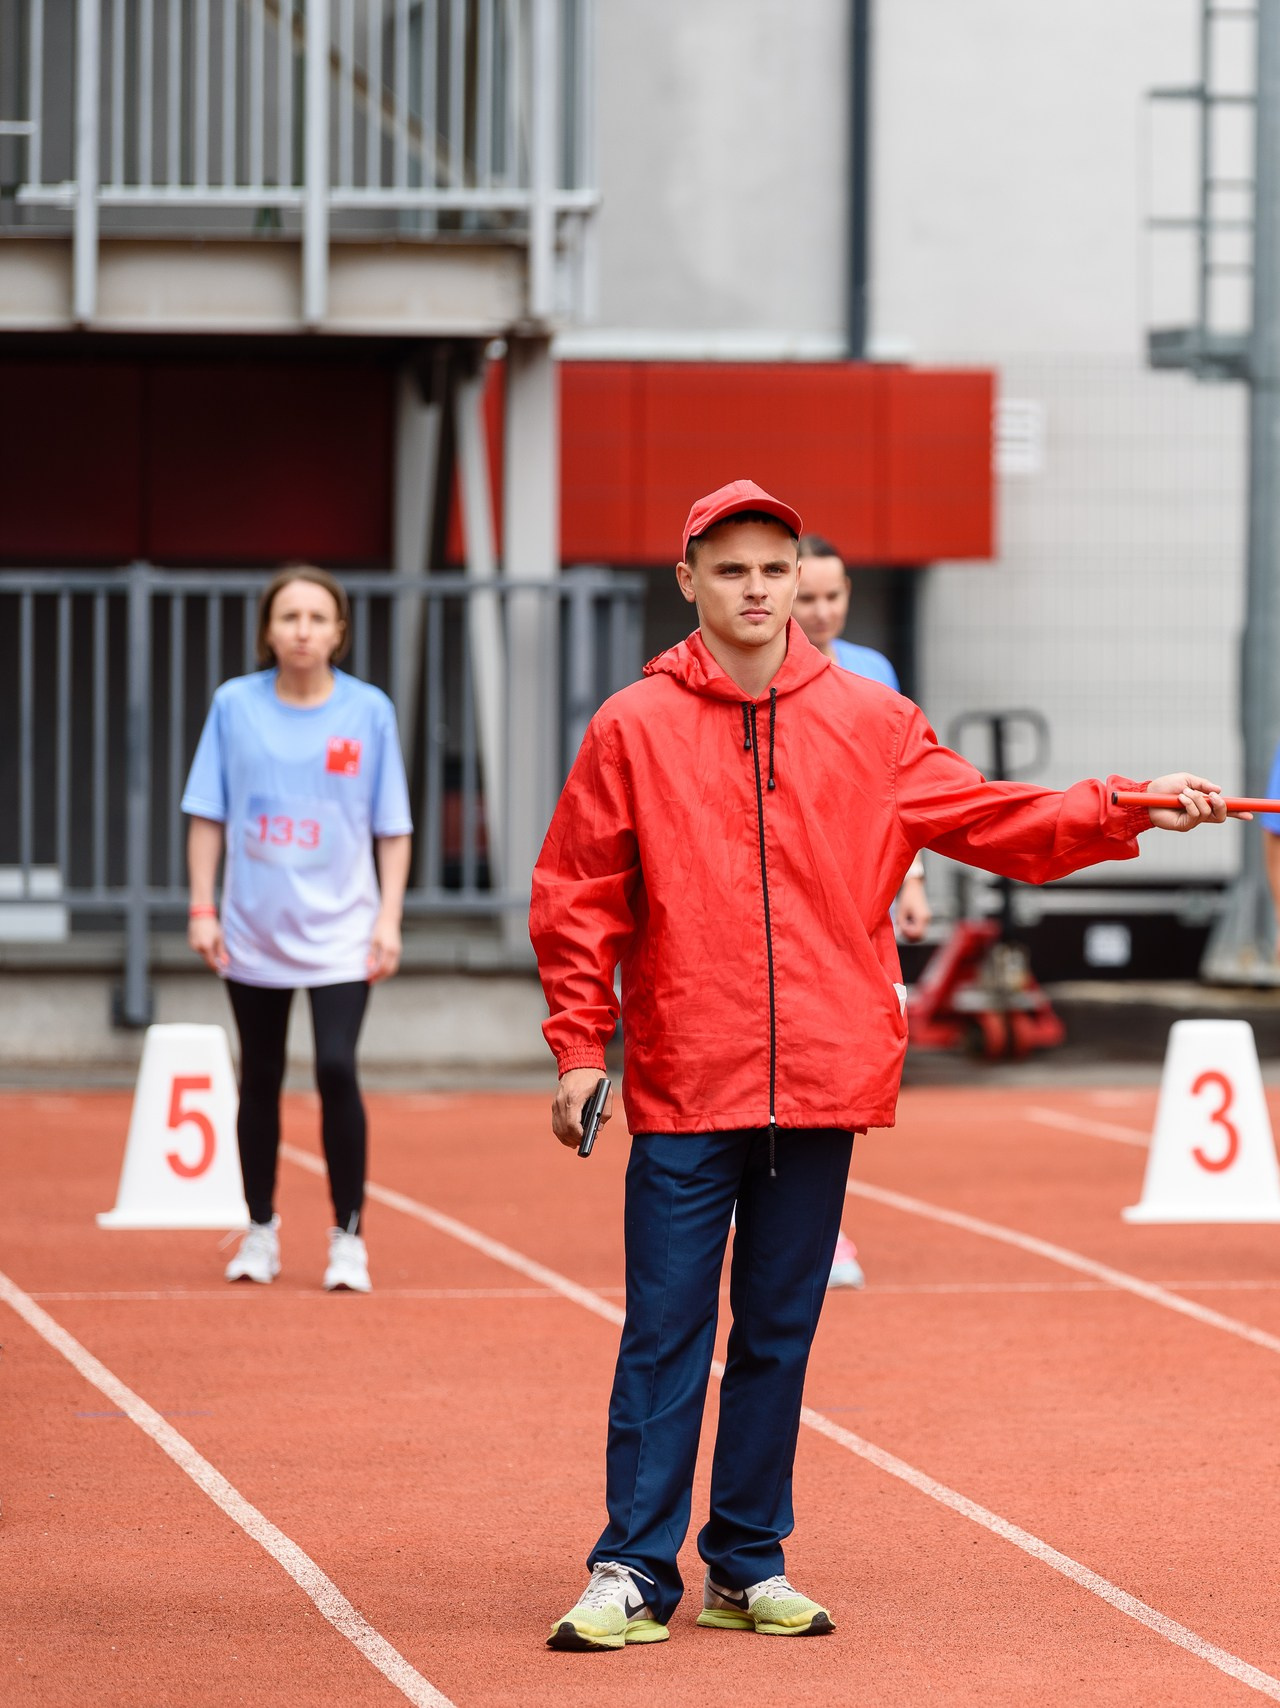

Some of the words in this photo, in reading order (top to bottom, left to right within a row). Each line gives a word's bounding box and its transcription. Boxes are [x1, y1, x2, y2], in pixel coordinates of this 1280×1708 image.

[258, 814, 322, 850] 133
[165, 1074, 217, 1180] 5
[1190, 1069, 1241, 1174] 3
